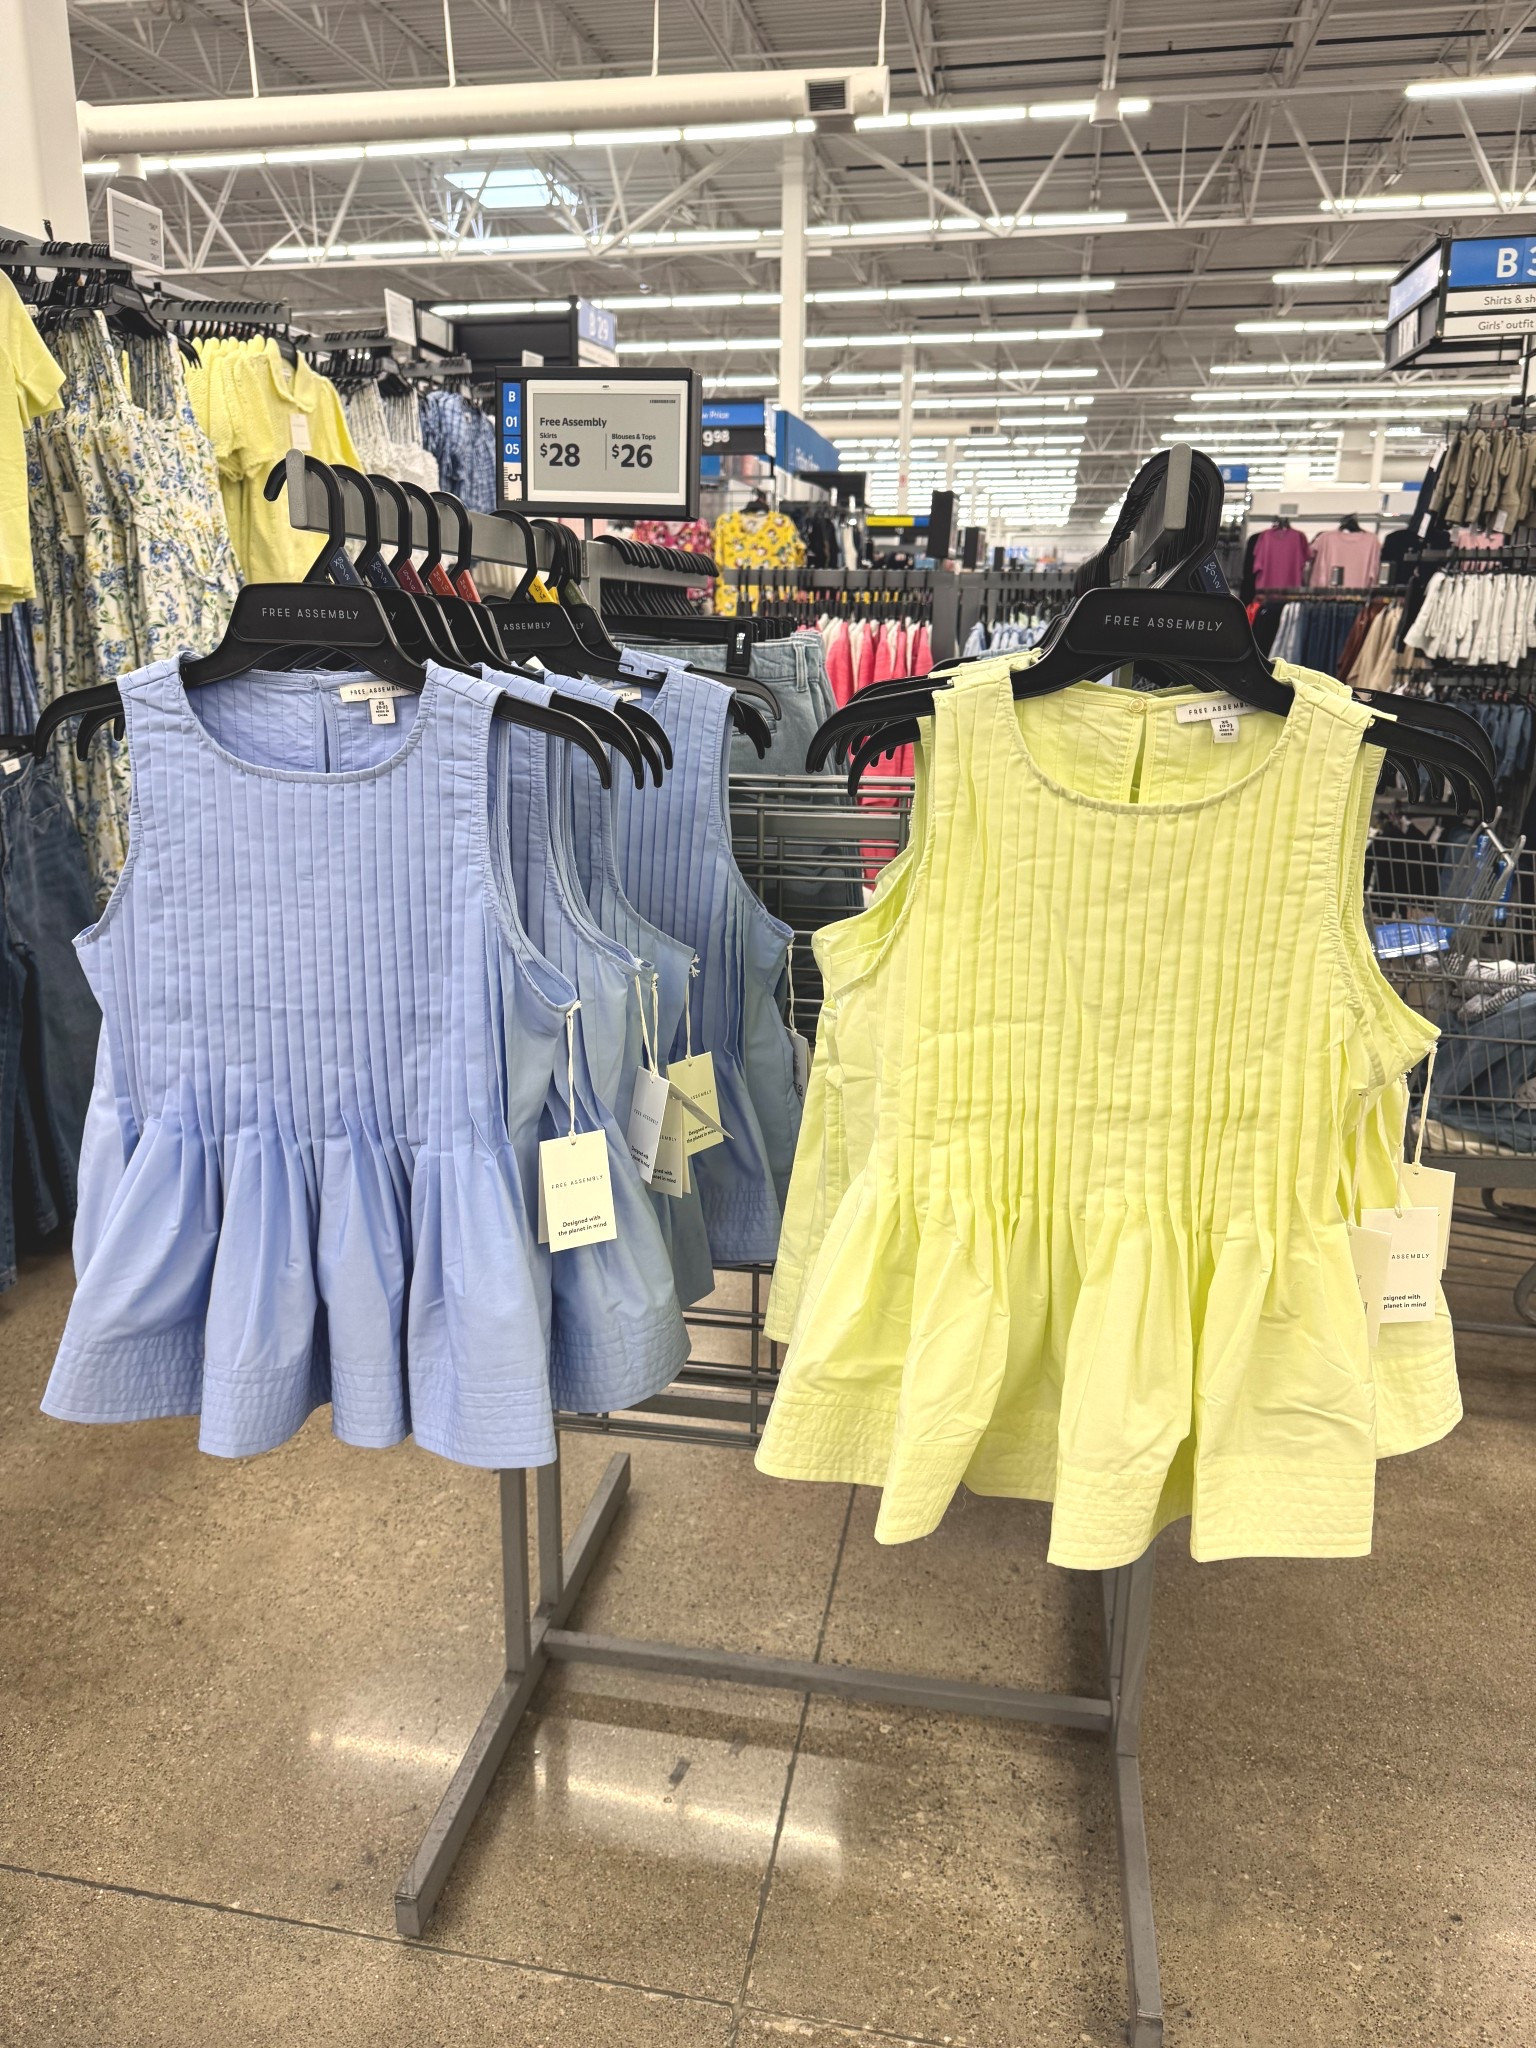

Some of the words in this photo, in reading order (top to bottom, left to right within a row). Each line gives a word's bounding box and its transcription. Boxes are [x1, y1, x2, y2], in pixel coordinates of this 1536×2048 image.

[1497, 247, 1519, 278] B
[1484, 296, 1512, 306] Shirts
[1515, 294, 1522, 304] &
[508, 390, 516, 402] B
[505, 416, 518, 428] 01
[540, 417, 560, 427] Free
[562, 417, 607, 429] Assembly
[505, 443, 520, 455] 05
[540, 443, 580, 467] $28
[612, 444, 653, 469] $26
[333, 556, 344, 567] XS
[371, 560, 382, 571] XS
[1203, 561, 1217, 573] XS
[262, 607, 291, 618] FREE
[297, 608, 359, 619] ASSEMBLY
[503, 622, 551, 630] ASSEMBLY
[1105, 615, 1140, 626] FREE
[1147, 617, 1223, 631] ASSEMBLY
[350, 688, 366, 696] FREE
[1189, 707, 1208, 715] FREE
[570, 1174, 604, 1186] ASSEMBLY
[562, 1216, 588, 1228] Designed
[589, 1214, 601, 1222] with
[568, 1226, 586, 1235] planet
[1383, 1302, 1402, 1310] planet
